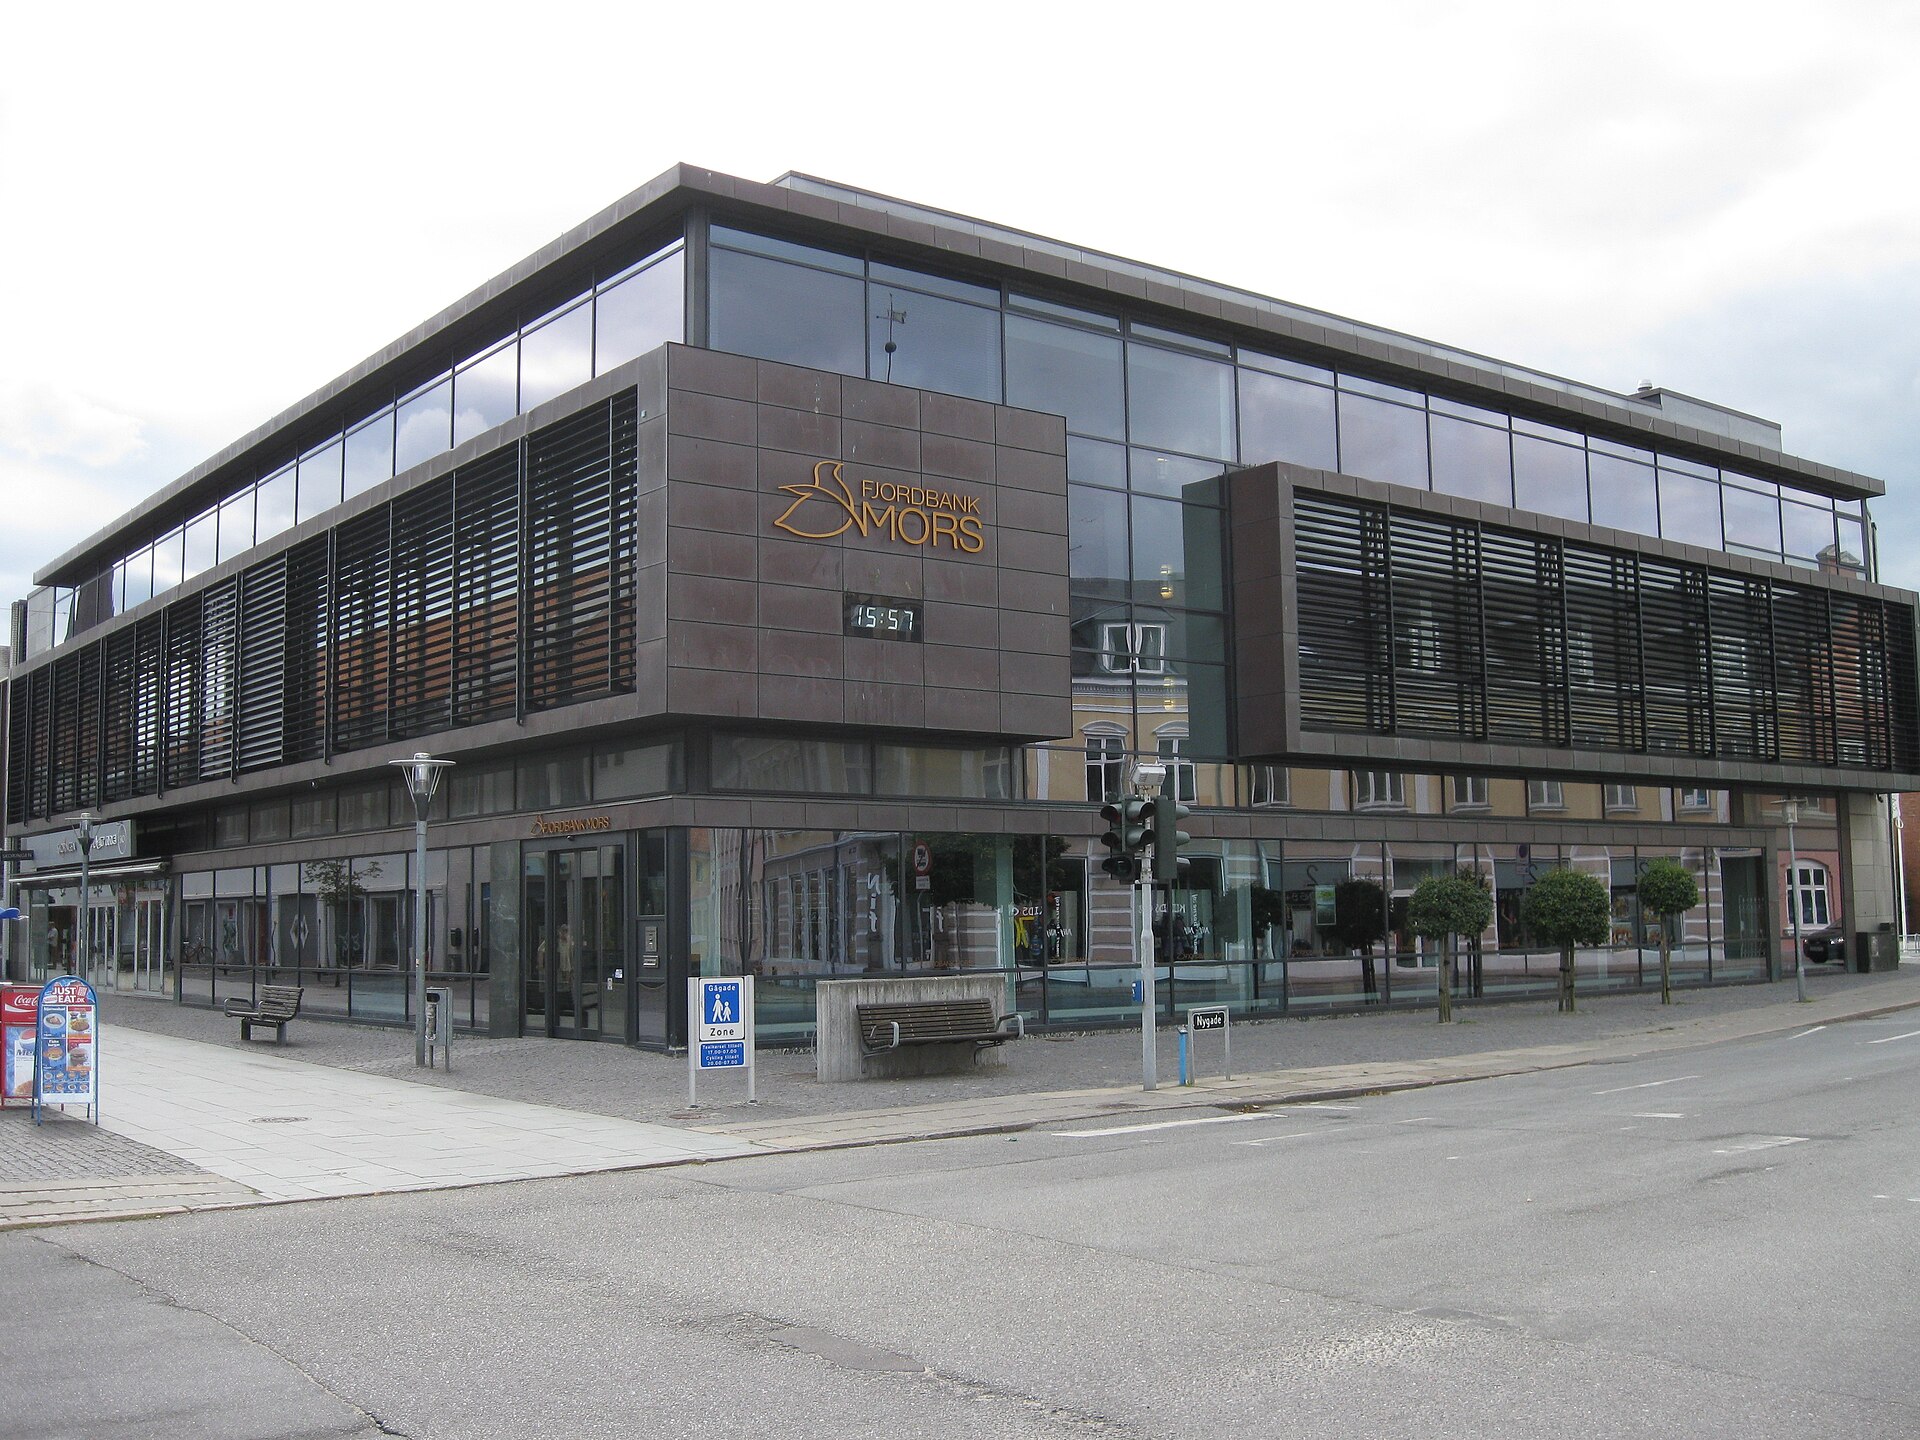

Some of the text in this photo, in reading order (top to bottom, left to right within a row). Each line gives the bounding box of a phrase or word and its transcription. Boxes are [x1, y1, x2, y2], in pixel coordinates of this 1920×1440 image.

[861, 480, 981, 514] FJORDBANK
[862, 501, 985, 553] MORS
[857, 606, 915, 631] 15:57
[544, 816, 609, 833] FJORDBANK MORS
[53, 987, 77, 995] JUST
[1197, 1015, 1221, 1028] Nygade
[710, 1028, 734, 1036] Zone
